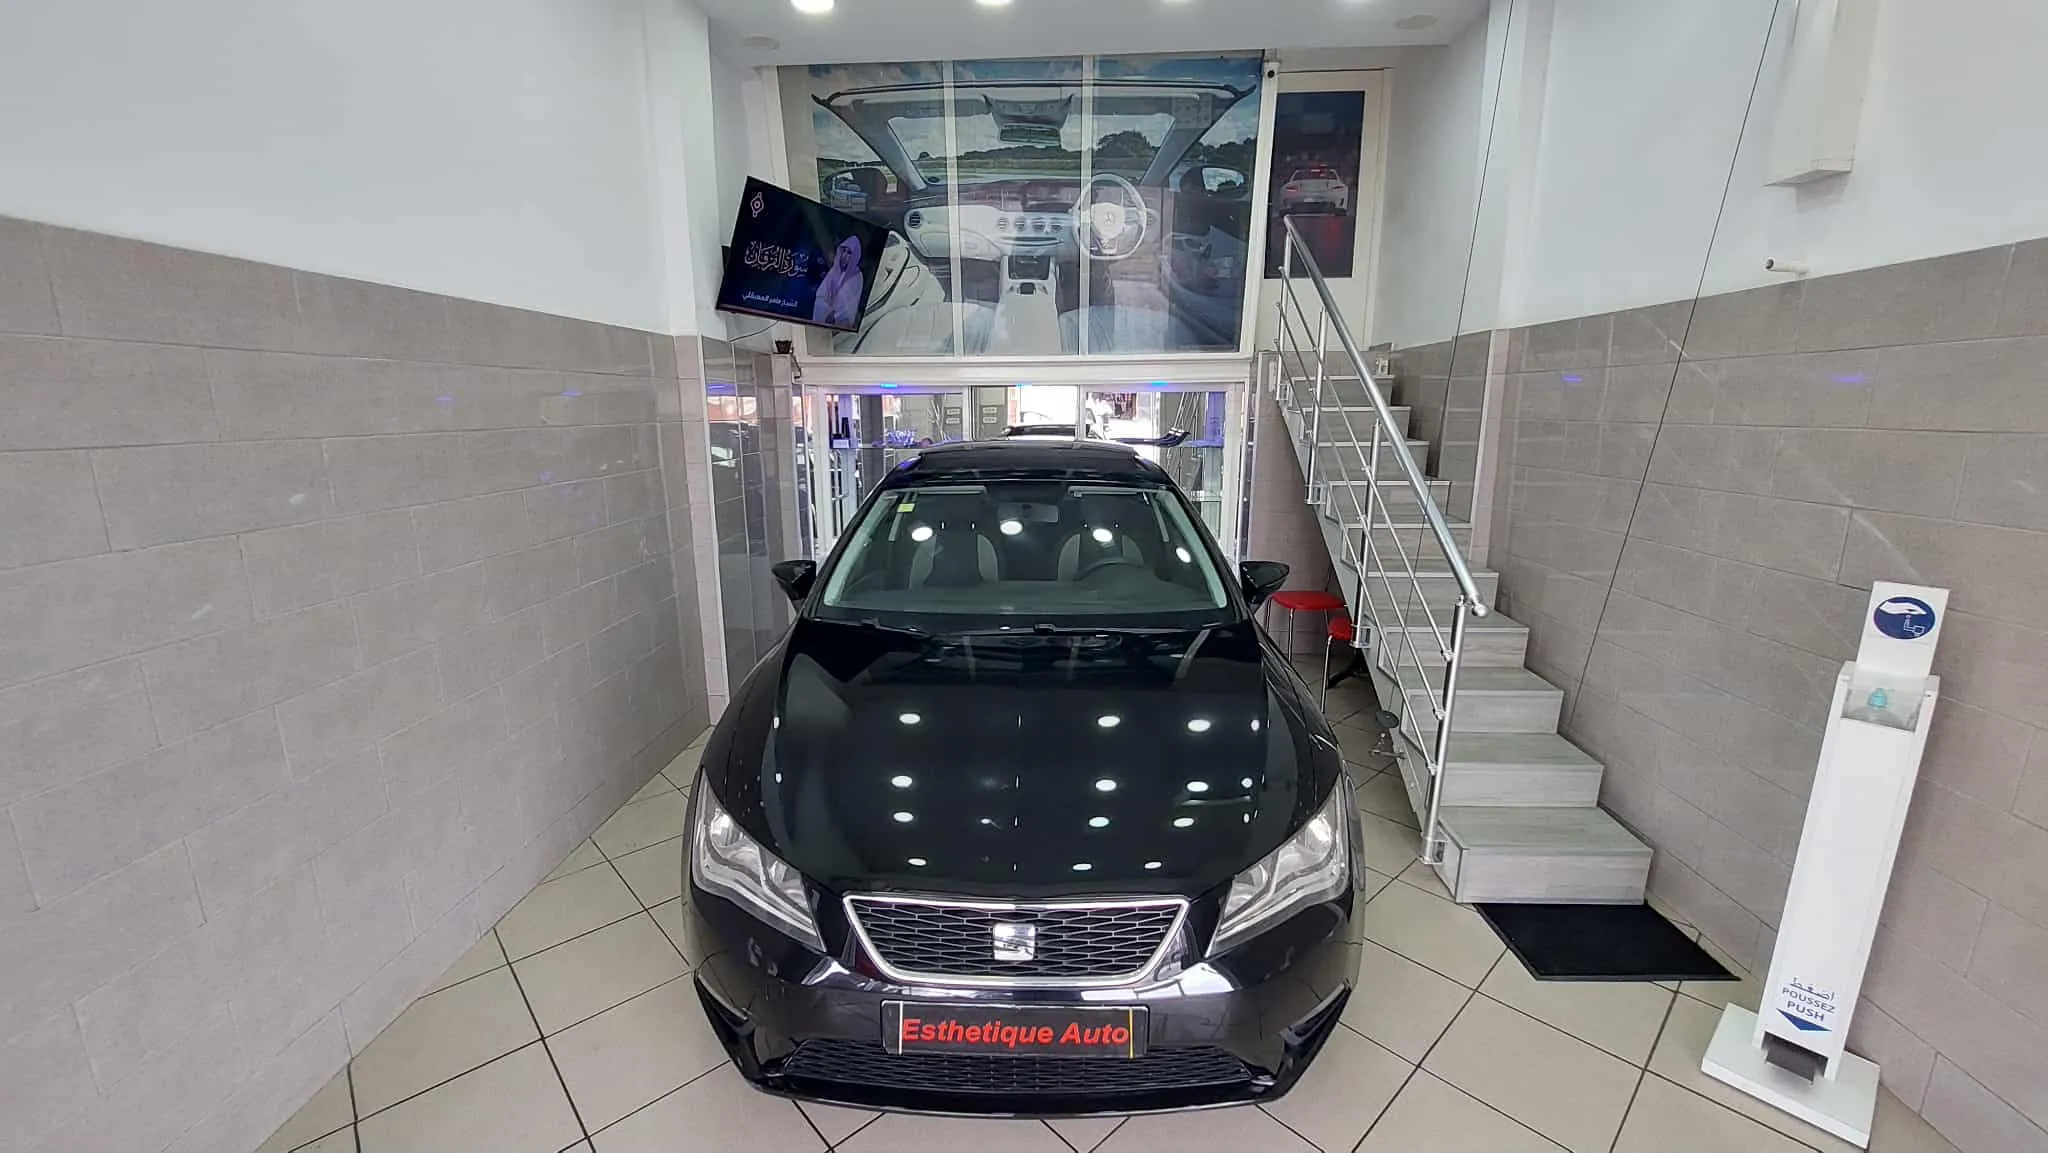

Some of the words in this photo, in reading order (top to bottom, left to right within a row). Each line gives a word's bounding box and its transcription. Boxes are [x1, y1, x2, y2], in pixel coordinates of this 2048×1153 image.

[1782, 987, 1835, 1014] POUSSEZ
[1787, 1000, 1824, 1021] PUSH
[902, 1018, 1054, 1049] Esthetique
[1059, 1022, 1129, 1045] Auto
